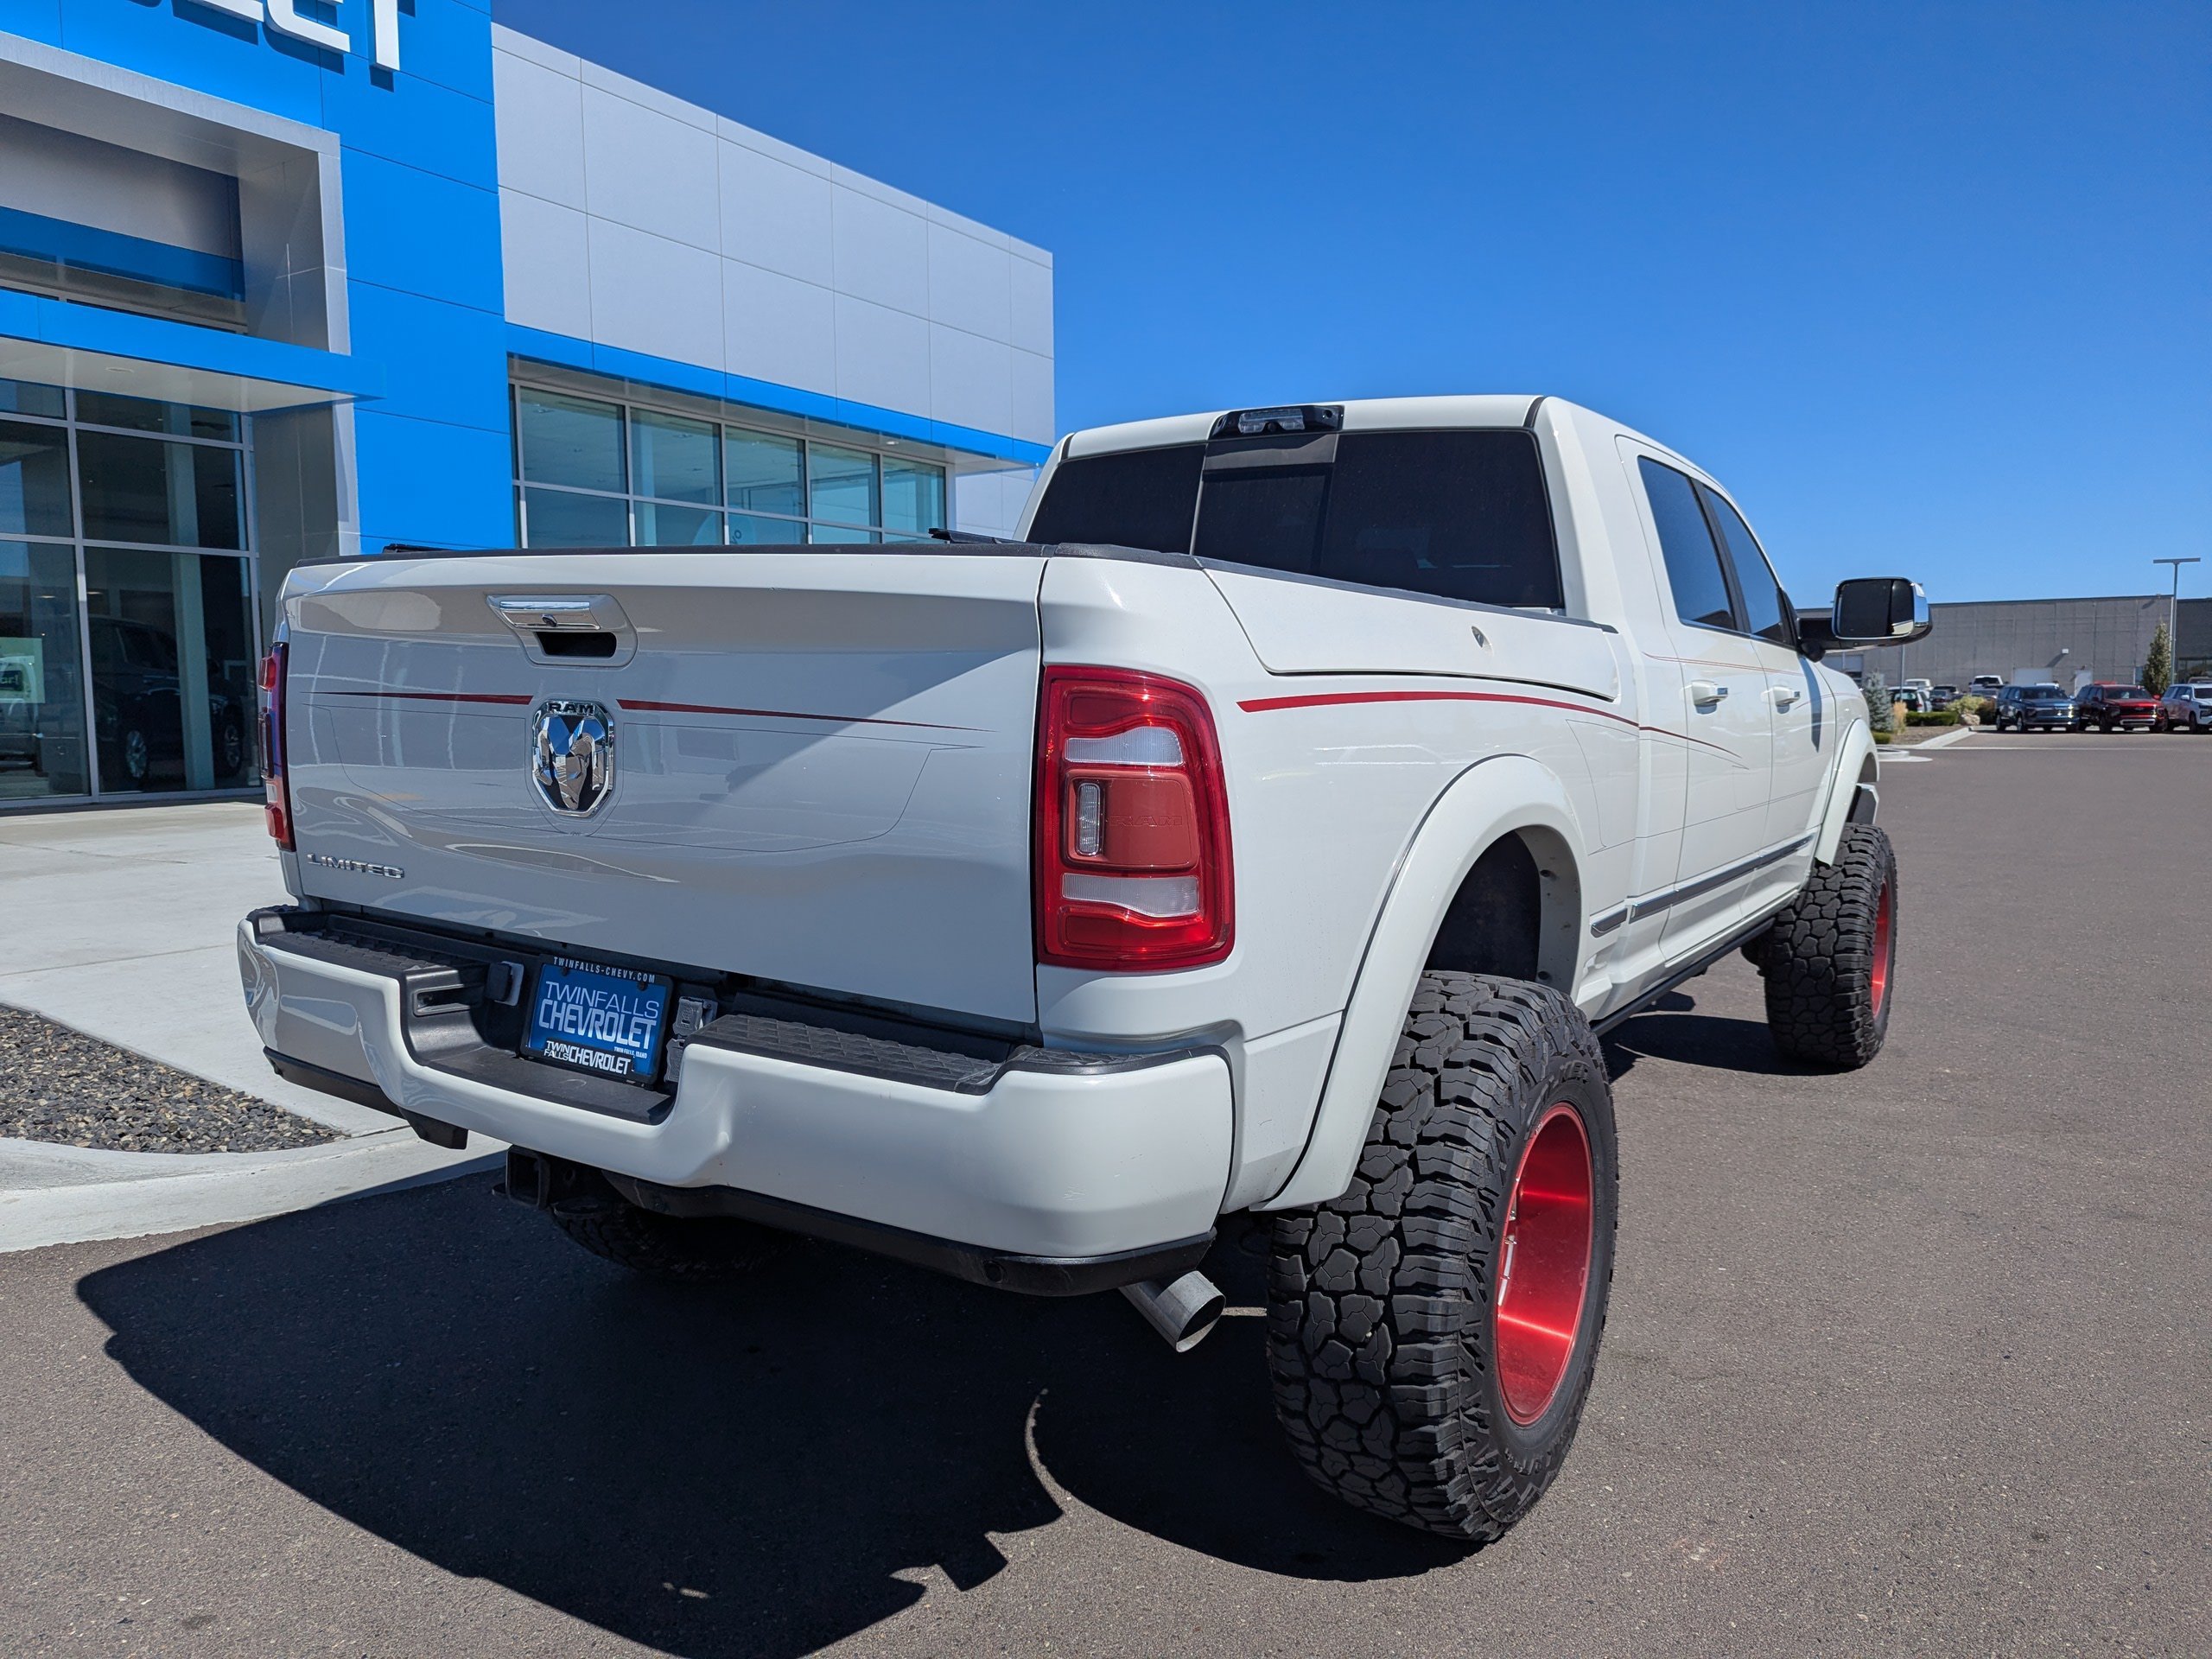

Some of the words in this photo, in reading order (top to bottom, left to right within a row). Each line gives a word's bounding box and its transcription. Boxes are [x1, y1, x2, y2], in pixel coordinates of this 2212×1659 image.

[548, 702, 594, 715] RAM
[1110, 815, 1183, 827] RAM
[307, 853, 404, 879] LIMITED
[553, 957, 655, 983] TWINFALLS-CHEVY.COM
[538, 999, 657, 1050] CHEVROLET
[543, 1048, 569, 1061] FALLS
[546, 1040, 571, 1054] TWIN
[568, 1046, 631, 1075] CHEVROLET
